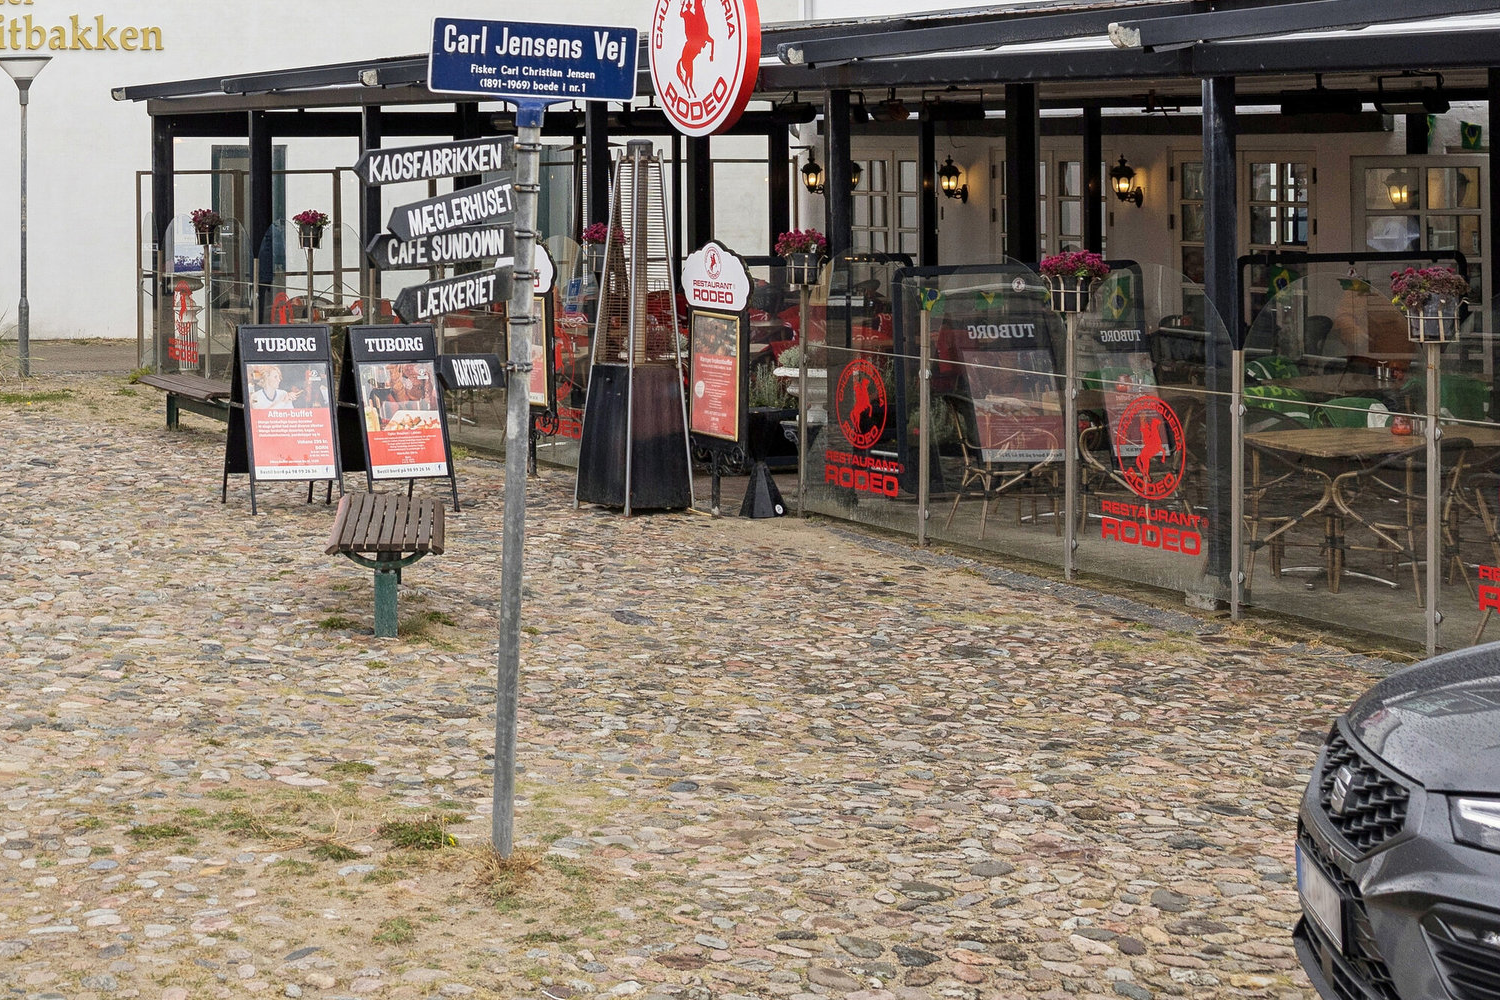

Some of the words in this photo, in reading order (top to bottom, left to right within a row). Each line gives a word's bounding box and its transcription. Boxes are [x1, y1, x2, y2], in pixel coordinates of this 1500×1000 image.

[443, 24, 488, 54] Carl
[495, 26, 583, 59] Jensens
[594, 31, 627, 68] Vej
[470, 64, 497, 75] Fisker
[500, 65, 519, 76] Carl
[522, 66, 563, 78] Christian
[566, 68, 596, 80] Jensen
[479, 79, 531, 90] (1891-1969)
[533, 80, 559, 92] boede
[665, 76, 728, 121] RODEO
[407, 184, 512, 238] MÆGLERHUSET
[388, 237, 428, 265] CAFE
[431, 229, 505, 262] SUNDOWN
[692, 279, 733, 290] RESTAURANT
[693, 288, 734, 305] RODEO
[253, 337, 317, 352] TUBORG
[364, 337, 424, 352] TUBORG
[267, 410, 313, 418] Aften-buffet
[842, 420, 879, 445] RODEO
[824, 464, 899, 497] RODEO
[1125, 466, 1175, 496] RODEO
[1102, 500, 1201, 527] RESTAURANT
[1101, 516, 1201, 556] RODEO
